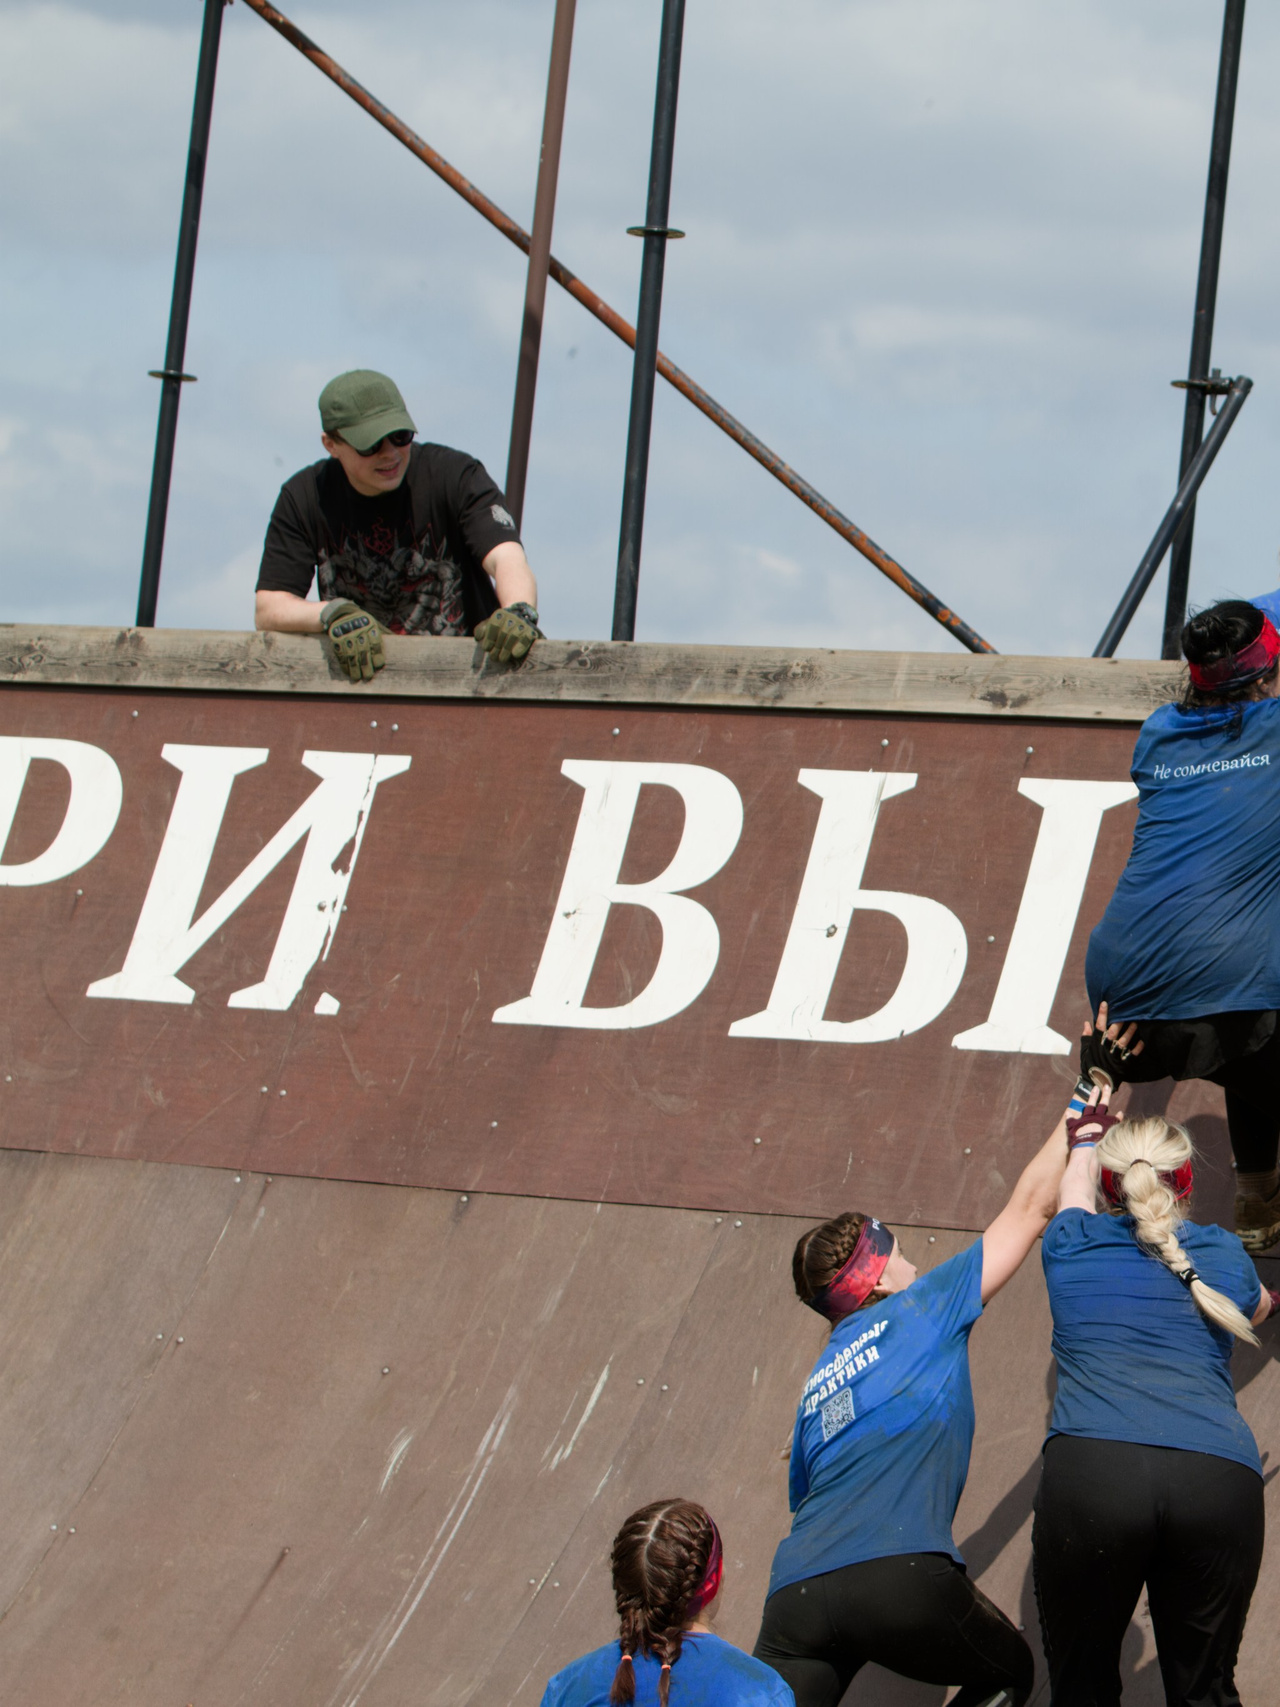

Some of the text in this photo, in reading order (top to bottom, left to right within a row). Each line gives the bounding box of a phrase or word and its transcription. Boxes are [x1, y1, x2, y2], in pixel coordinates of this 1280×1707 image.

[1154, 752, 1271, 780] Не сомневайся
[804, 1345, 880, 1417] практики
